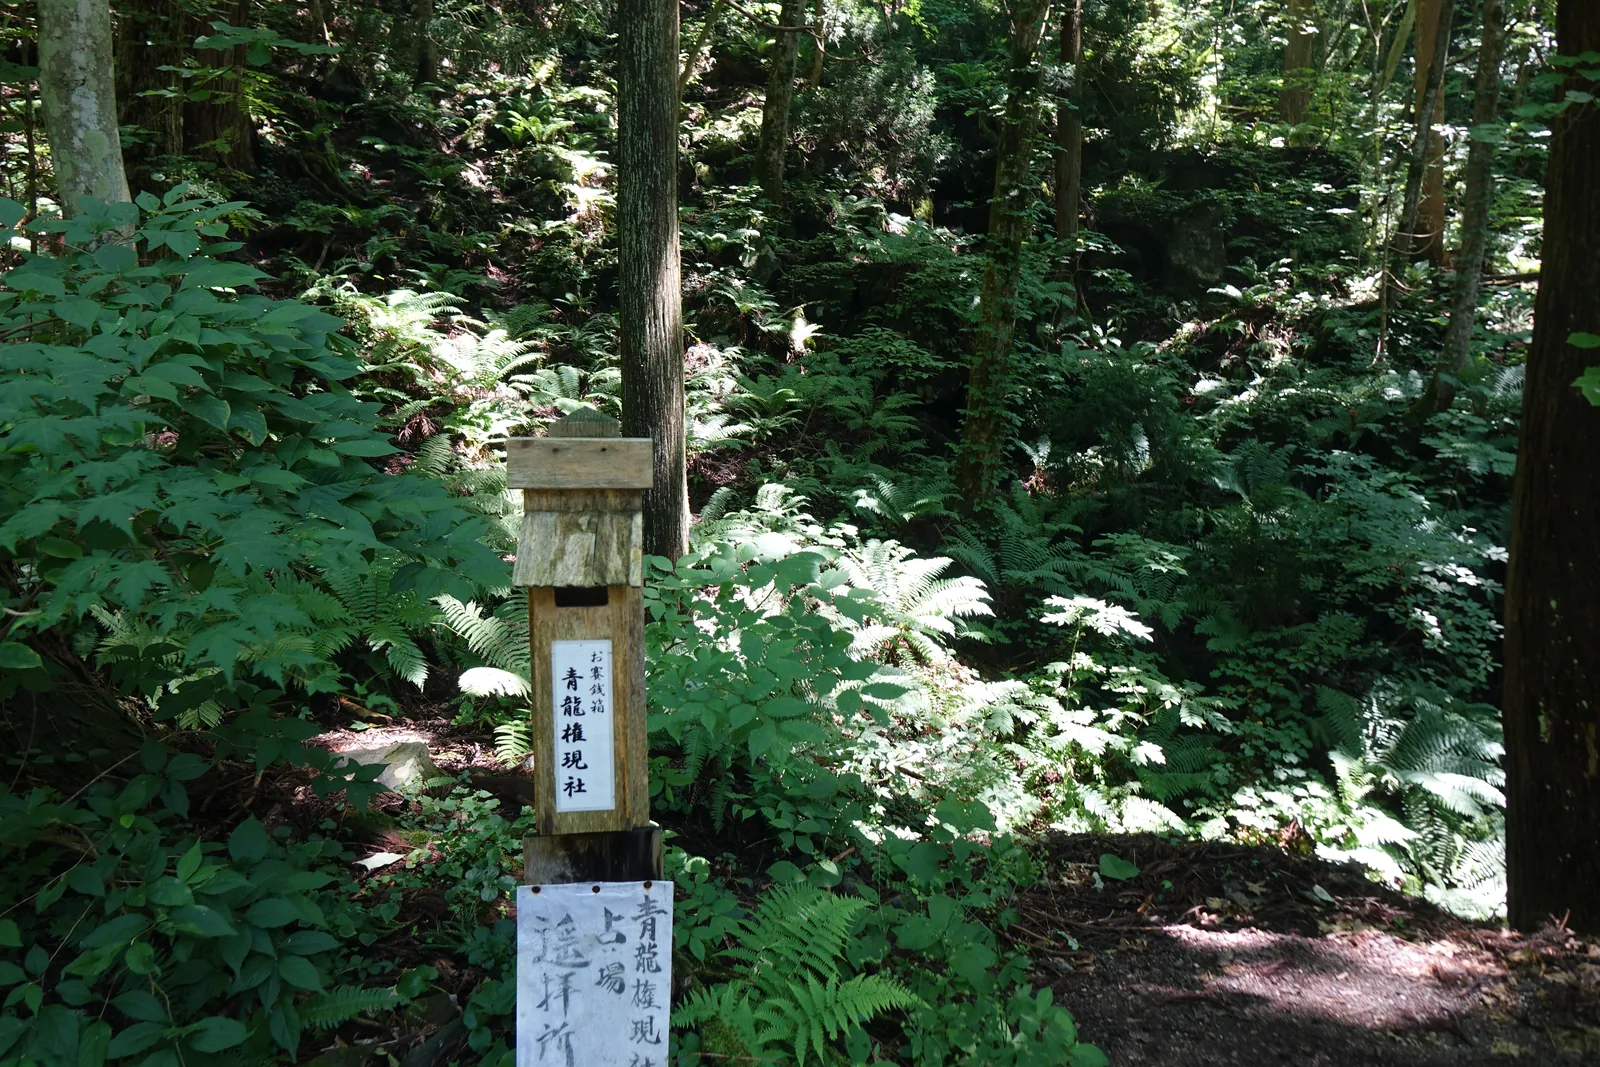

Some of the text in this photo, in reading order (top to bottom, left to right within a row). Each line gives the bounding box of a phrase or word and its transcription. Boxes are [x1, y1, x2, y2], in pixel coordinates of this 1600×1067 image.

[589, 651, 605, 713] お賽銭箱
[560, 666, 588, 798] 青龍権現社
